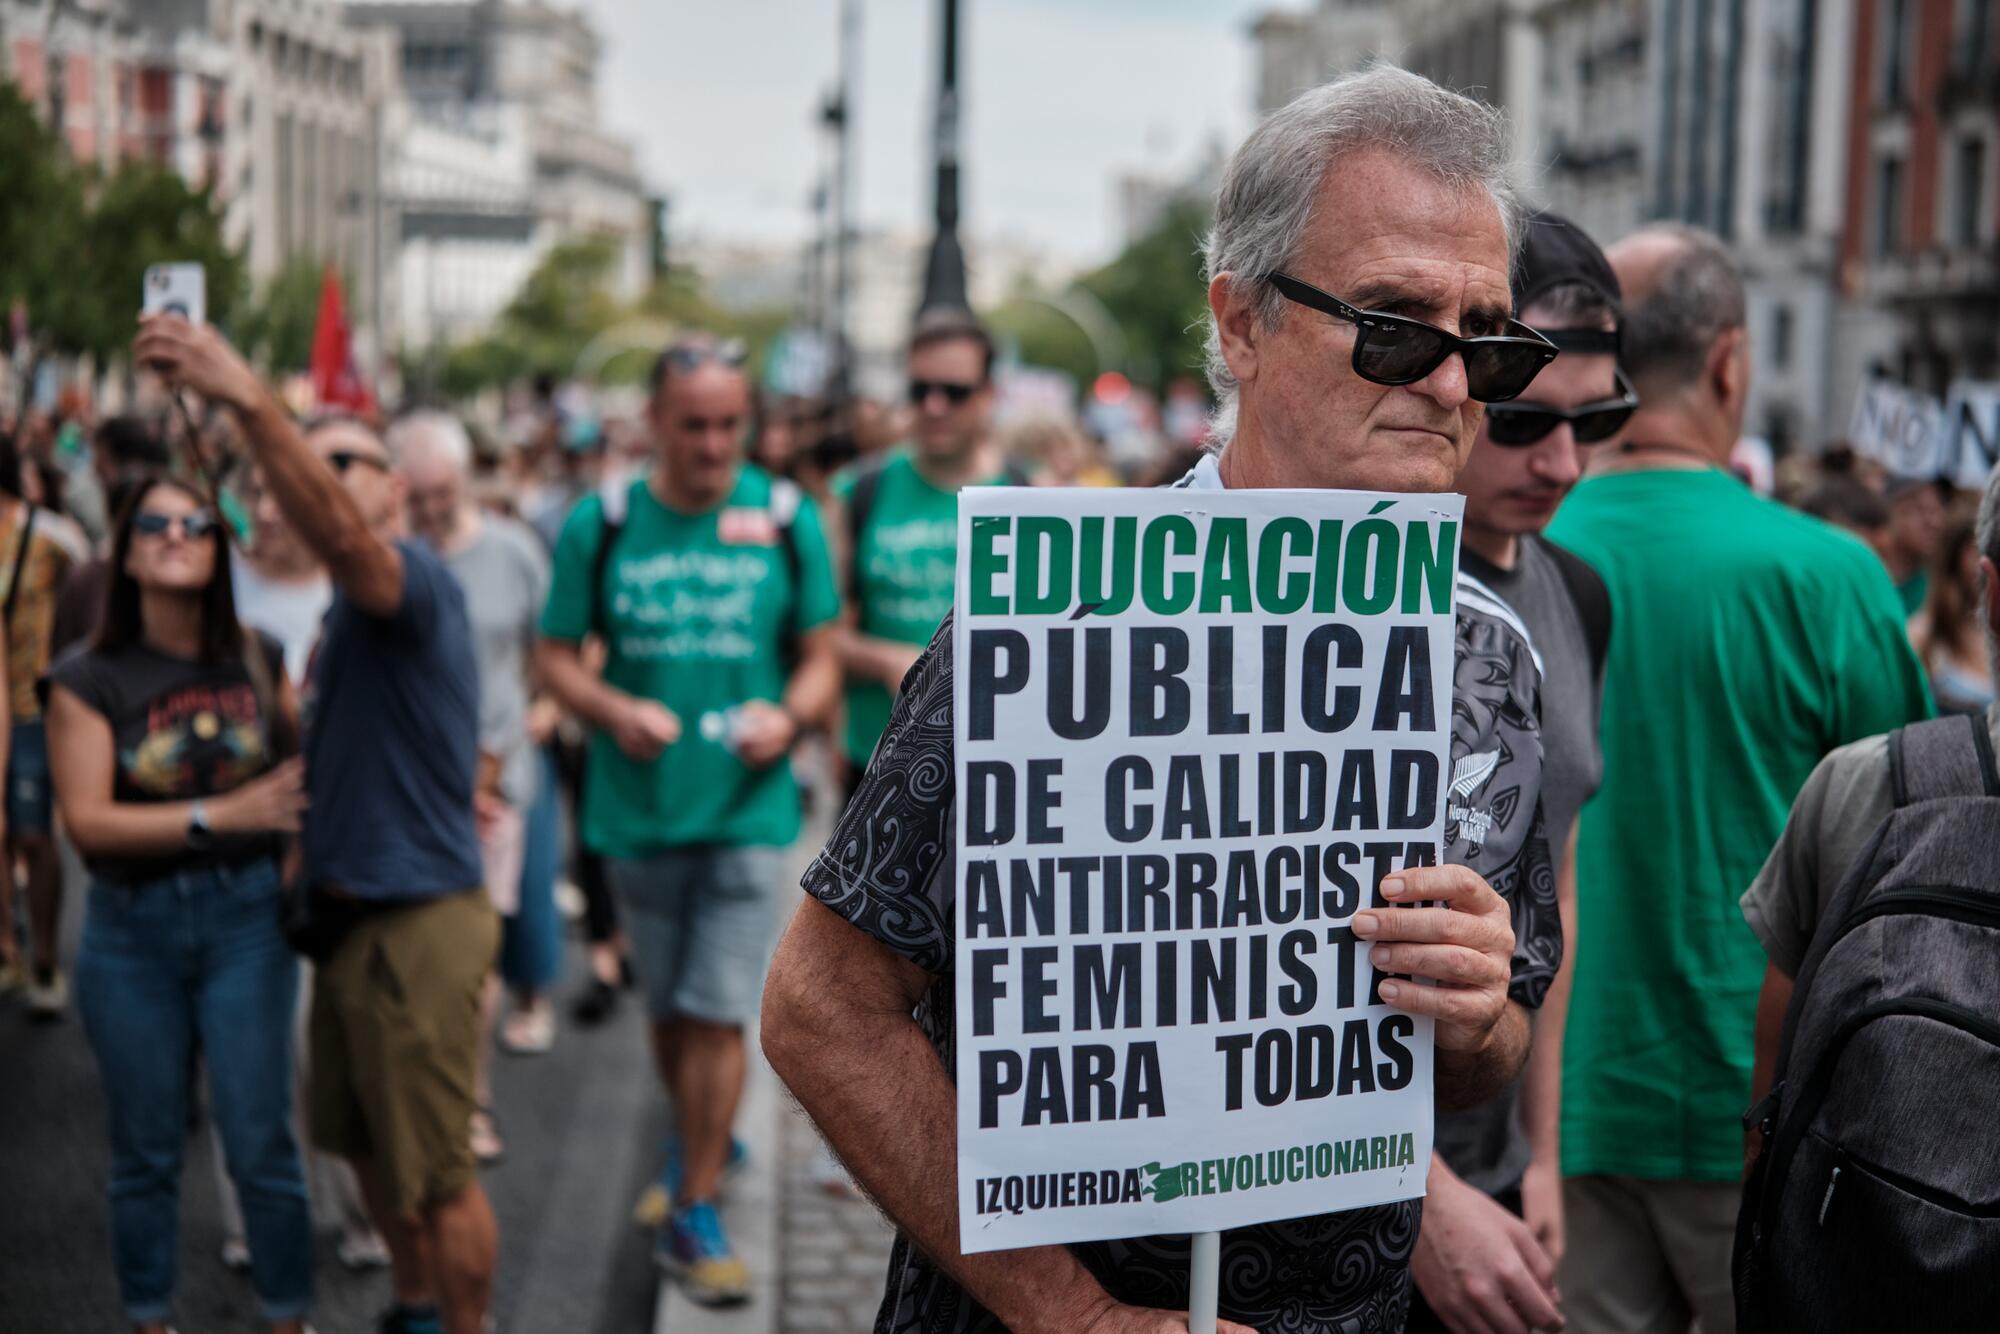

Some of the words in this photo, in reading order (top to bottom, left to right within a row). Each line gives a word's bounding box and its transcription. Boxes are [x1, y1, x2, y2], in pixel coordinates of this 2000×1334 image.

[970, 501, 1457, 615] EDUCACIÓN
[969, 603, 1436, 741] PÚBLICA
[966, 759, 1064, 846] DE
[1105, 749, 1439, 843] CALIDAD
[972, 926, 1413, 1036] FEMINIST
[979, 1041, 1167, 1128] PARA
[1216, 1014, 1414, 1111] TODAS
[976, 1168, 1142, 1215] IZQUIERDA
[1182, 1133, 1415, 1196] REVOLUCIONARIA
